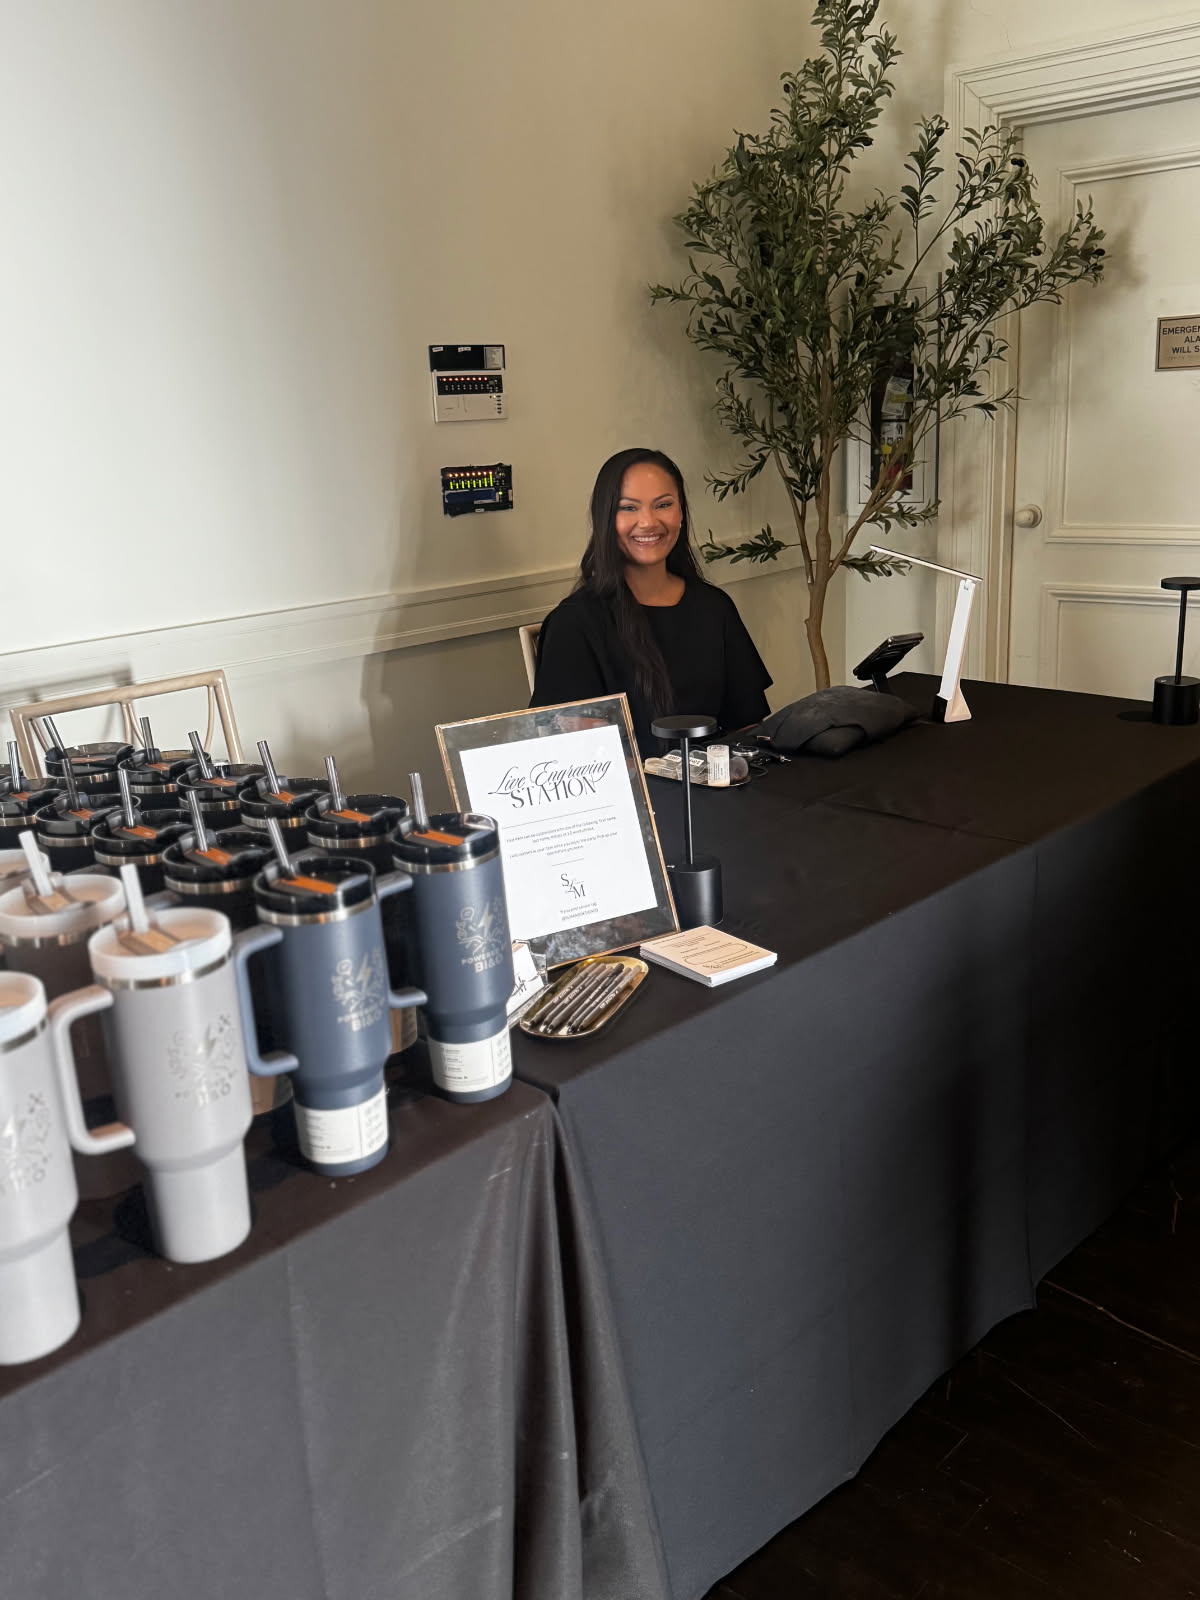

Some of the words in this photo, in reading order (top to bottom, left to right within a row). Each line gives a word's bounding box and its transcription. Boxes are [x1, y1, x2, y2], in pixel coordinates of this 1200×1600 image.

[1172, 346, 1191, 354] WILL
[488, 766, 526, 795] Live
[530, 760, 612, 792] Engraving
[510, 777, 596, 808] STATION
